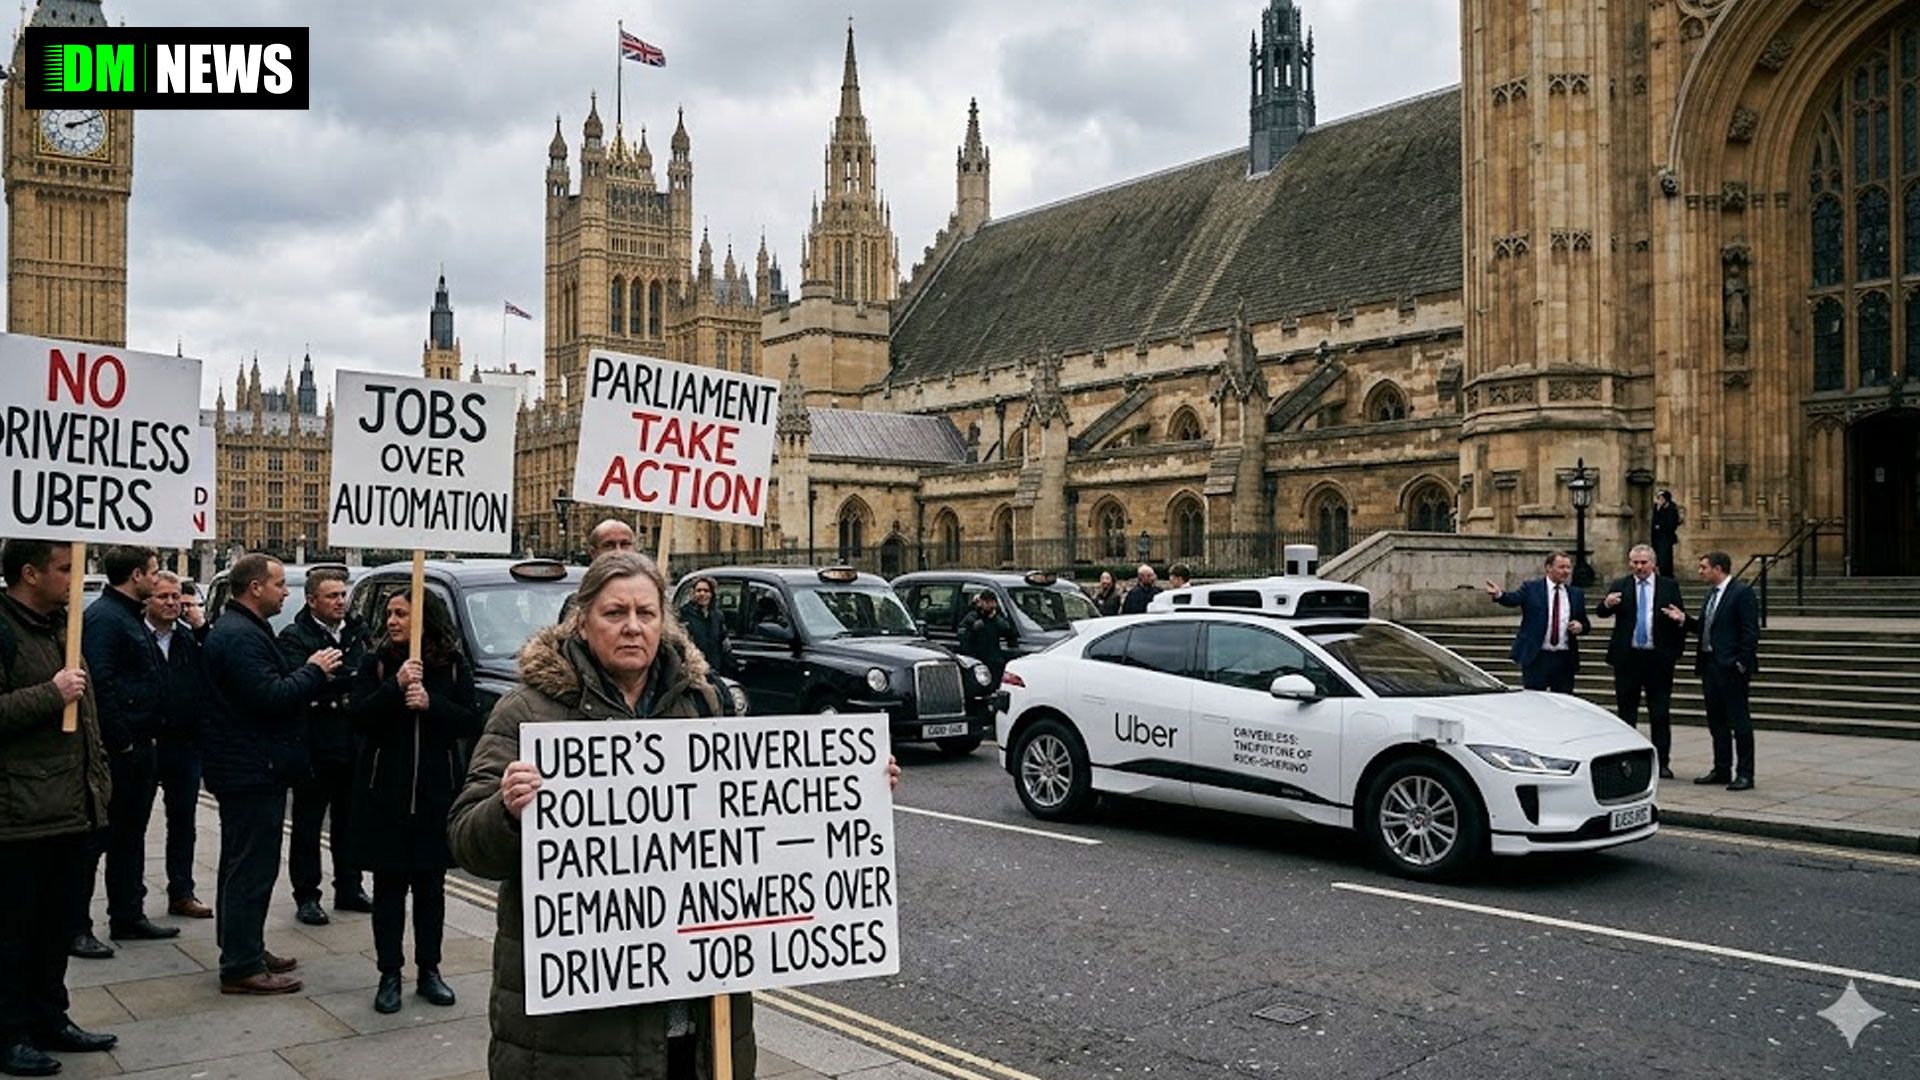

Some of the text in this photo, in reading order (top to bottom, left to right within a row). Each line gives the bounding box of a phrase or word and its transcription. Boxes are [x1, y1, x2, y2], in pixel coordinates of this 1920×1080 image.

[47, 348, 127, 409] NO
[591, 357, 777, 425] PARLIAMENT
[0, 406, 190, 475] RIVERLESS
[358, 384, 487, 443] JOBS
[632, 411, 740, 466] TAKE
[381, 443, 465, 477] OVER
[598, 455, 762, 516] ACTION
[12, 468, 153, 533] UBERS
[332, 483, 507, 534] AUTOMATION
[535, 727, 877, 780] UBER'S DRIVERLESS
[1115, 712, 1178, 748] Uber
[536, 775, 862, 830] ROLLOUT REACHES
[538, 826, 765, 881] PARLIAMENT
[827, 818, 884, 858] MPs
[535, 866, 892, 938] DEMAND ANSWERS OVER
[541, 920, 886, 999] DRIVER JOB LOSSES
